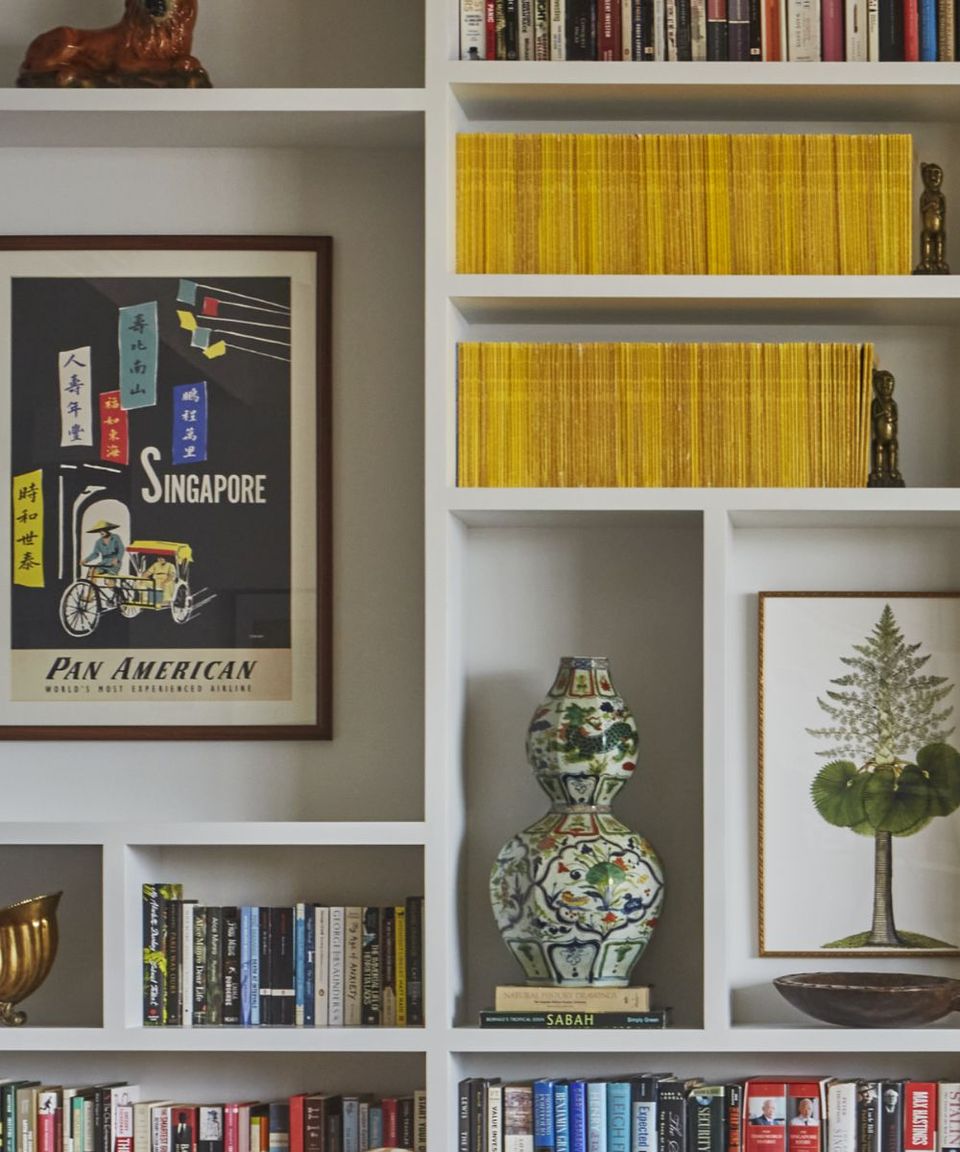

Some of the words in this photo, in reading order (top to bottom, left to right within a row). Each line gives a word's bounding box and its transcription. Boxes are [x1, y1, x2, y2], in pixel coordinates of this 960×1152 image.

[487, 4, 496, 23] PANIC
[141, 445, 267, 503] SINGAPORE
[45, 656, 104, 680] PAN
[111, 656, 258, 680] AMERICAN
[45, 684, 90, 693] WORLD'S
[98, 684, 124, 693] MOST
[131, 684, 203, 693] EXPERIENCED
[210, 684, 253, 693] AIRLINE
[196, 918, 204, 937] Alice
[332, 911, 340, 947] GEORGE
[196, 937, 204, 964] Munro
[196, 965, 204, 984] Dear
[332, 959, 340, 1013] SAUNDERS
[348, 963, 358, 1000] ANXIETY
[196, 986, 204, 1002] Life
[546, 1014, 594, 1025] SABAH
[418, 1096, 426, 1119] START
[556, 1092, 568, 1133] BENJAMIN
[591, 1091, 601, 1130] HENRY
[912, 1092, 928, 1109] MAX
[612, 1095, 625, 1138] LEIGH
[637, 1106, 650, 1147] Expected
[669, 1112, 682, 1136] The
[698, 1107, 710, 1152] SECURITY
[912, 1109, 928, 1145] HASTINGS
[949, 1091, 960, 1145] STALIN
[160, 1117, 168, 1144] SMARTEST
